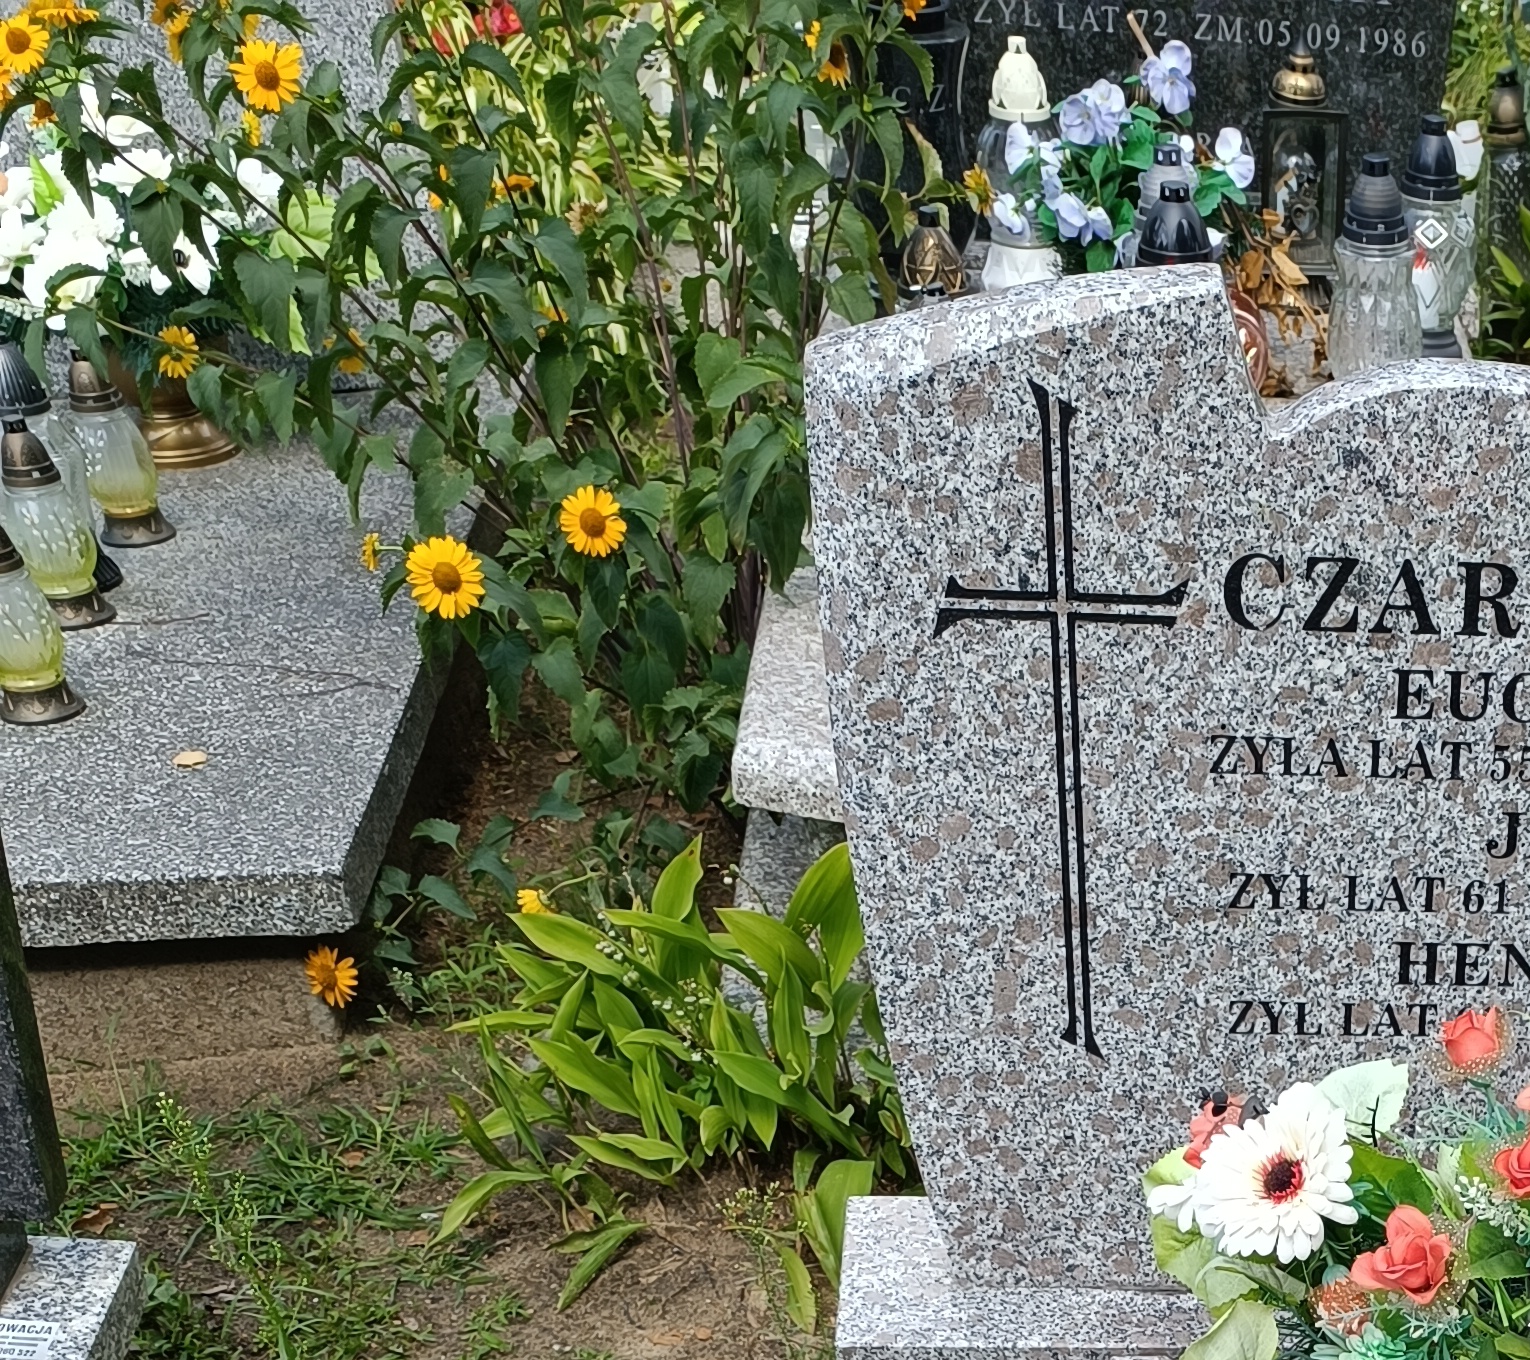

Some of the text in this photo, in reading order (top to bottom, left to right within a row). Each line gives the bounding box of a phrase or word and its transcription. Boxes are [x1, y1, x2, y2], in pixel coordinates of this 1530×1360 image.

[1056, 5, 1120, 34] LAT
[1366, 737, 1473, 784] LAT
[1345, 873, 1447, 914] LAT
[1462, 878, 1510, 916] 61
[1340, 1002, 1439, 1038] LAT
